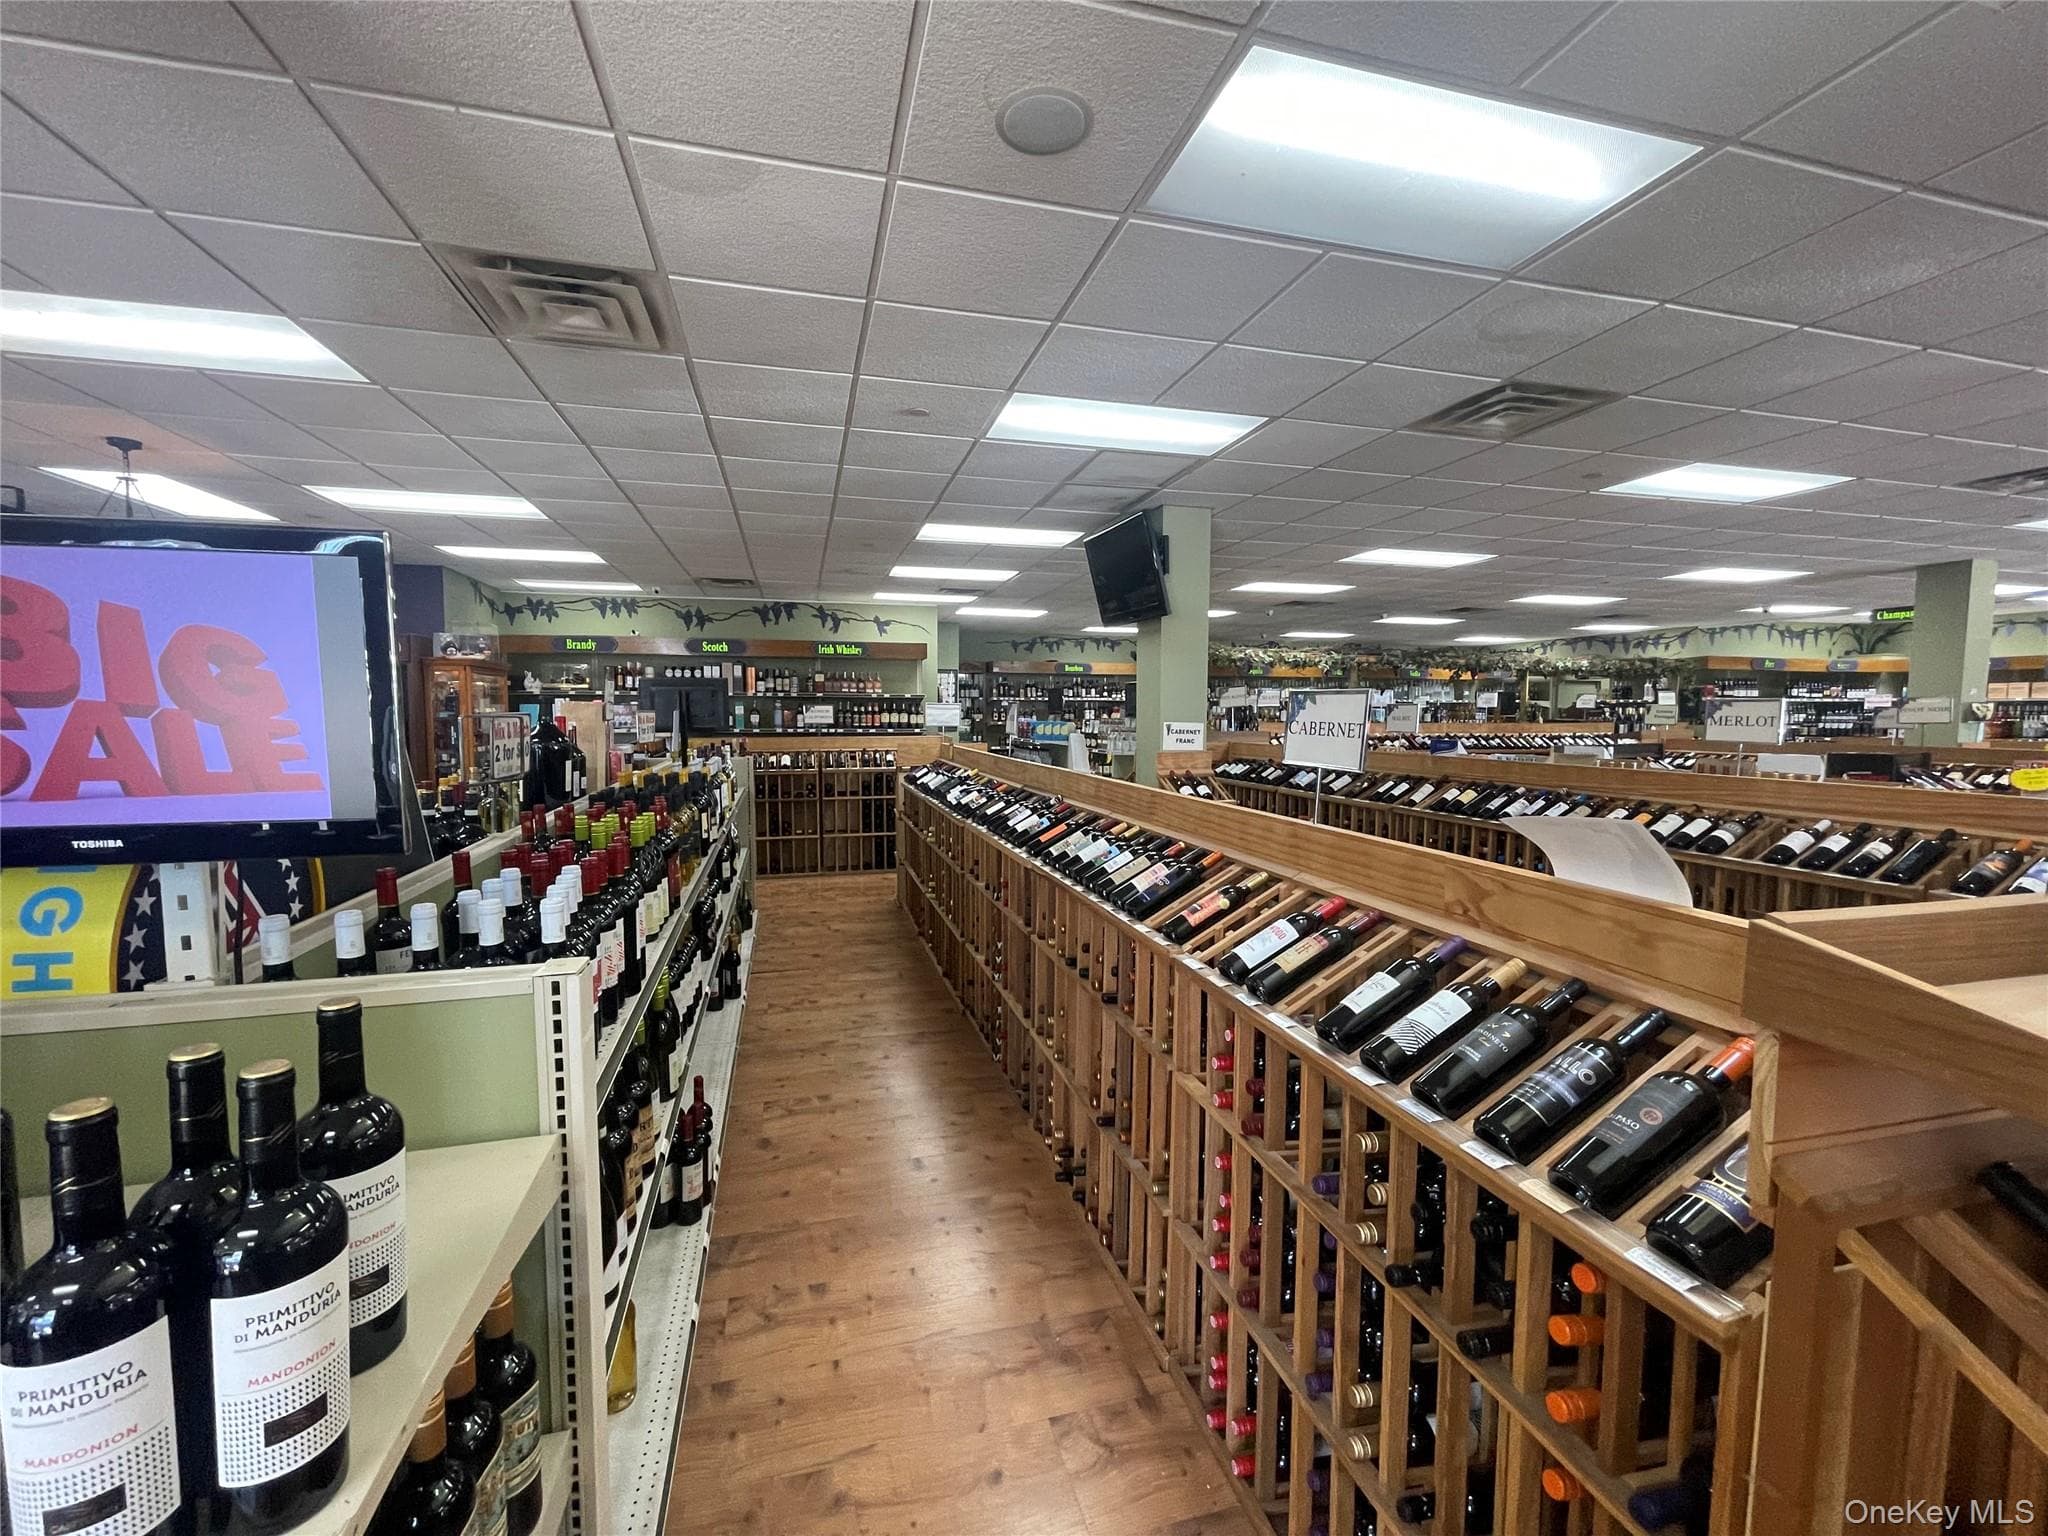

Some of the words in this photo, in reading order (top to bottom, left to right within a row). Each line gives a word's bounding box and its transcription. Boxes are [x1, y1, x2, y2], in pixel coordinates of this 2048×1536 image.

[566, 639, 597, 651] Brandy
[702, 641, 728, 652] Scotch
[818, 644, 835, 655] Irish
[836, 645, 863, 657] Whiskey
[1287, 719, 1365, 740] CABERNET
[1709, 714, 1777, 728] MERLOT
[1169, 728, 1201, 736] CABERNET
[1175, 737, 1196, 745] FRANC
[494, 744, 500, 762] 2
[502, 743, 515, 761] for
[71, 839, 124, 849] TOSHIBA
[343, 1174, 396, 1203] IMITIVO
[347, 1181, 400, 1212] ANDURIA
[245, 1280, 336, 1329] PRIMITIVO
[234, 1334, 249, 1344] DI
[255, 1287, 342, 1340] MANDURIA
[247, 1337, 337, 1388] MANDONION
[18, 1361, 134, 1403] PRIMITIVO
[28, 1368, 148, 1418] MANDURIA
[24, 1423, 139, 1468] MANDONION
